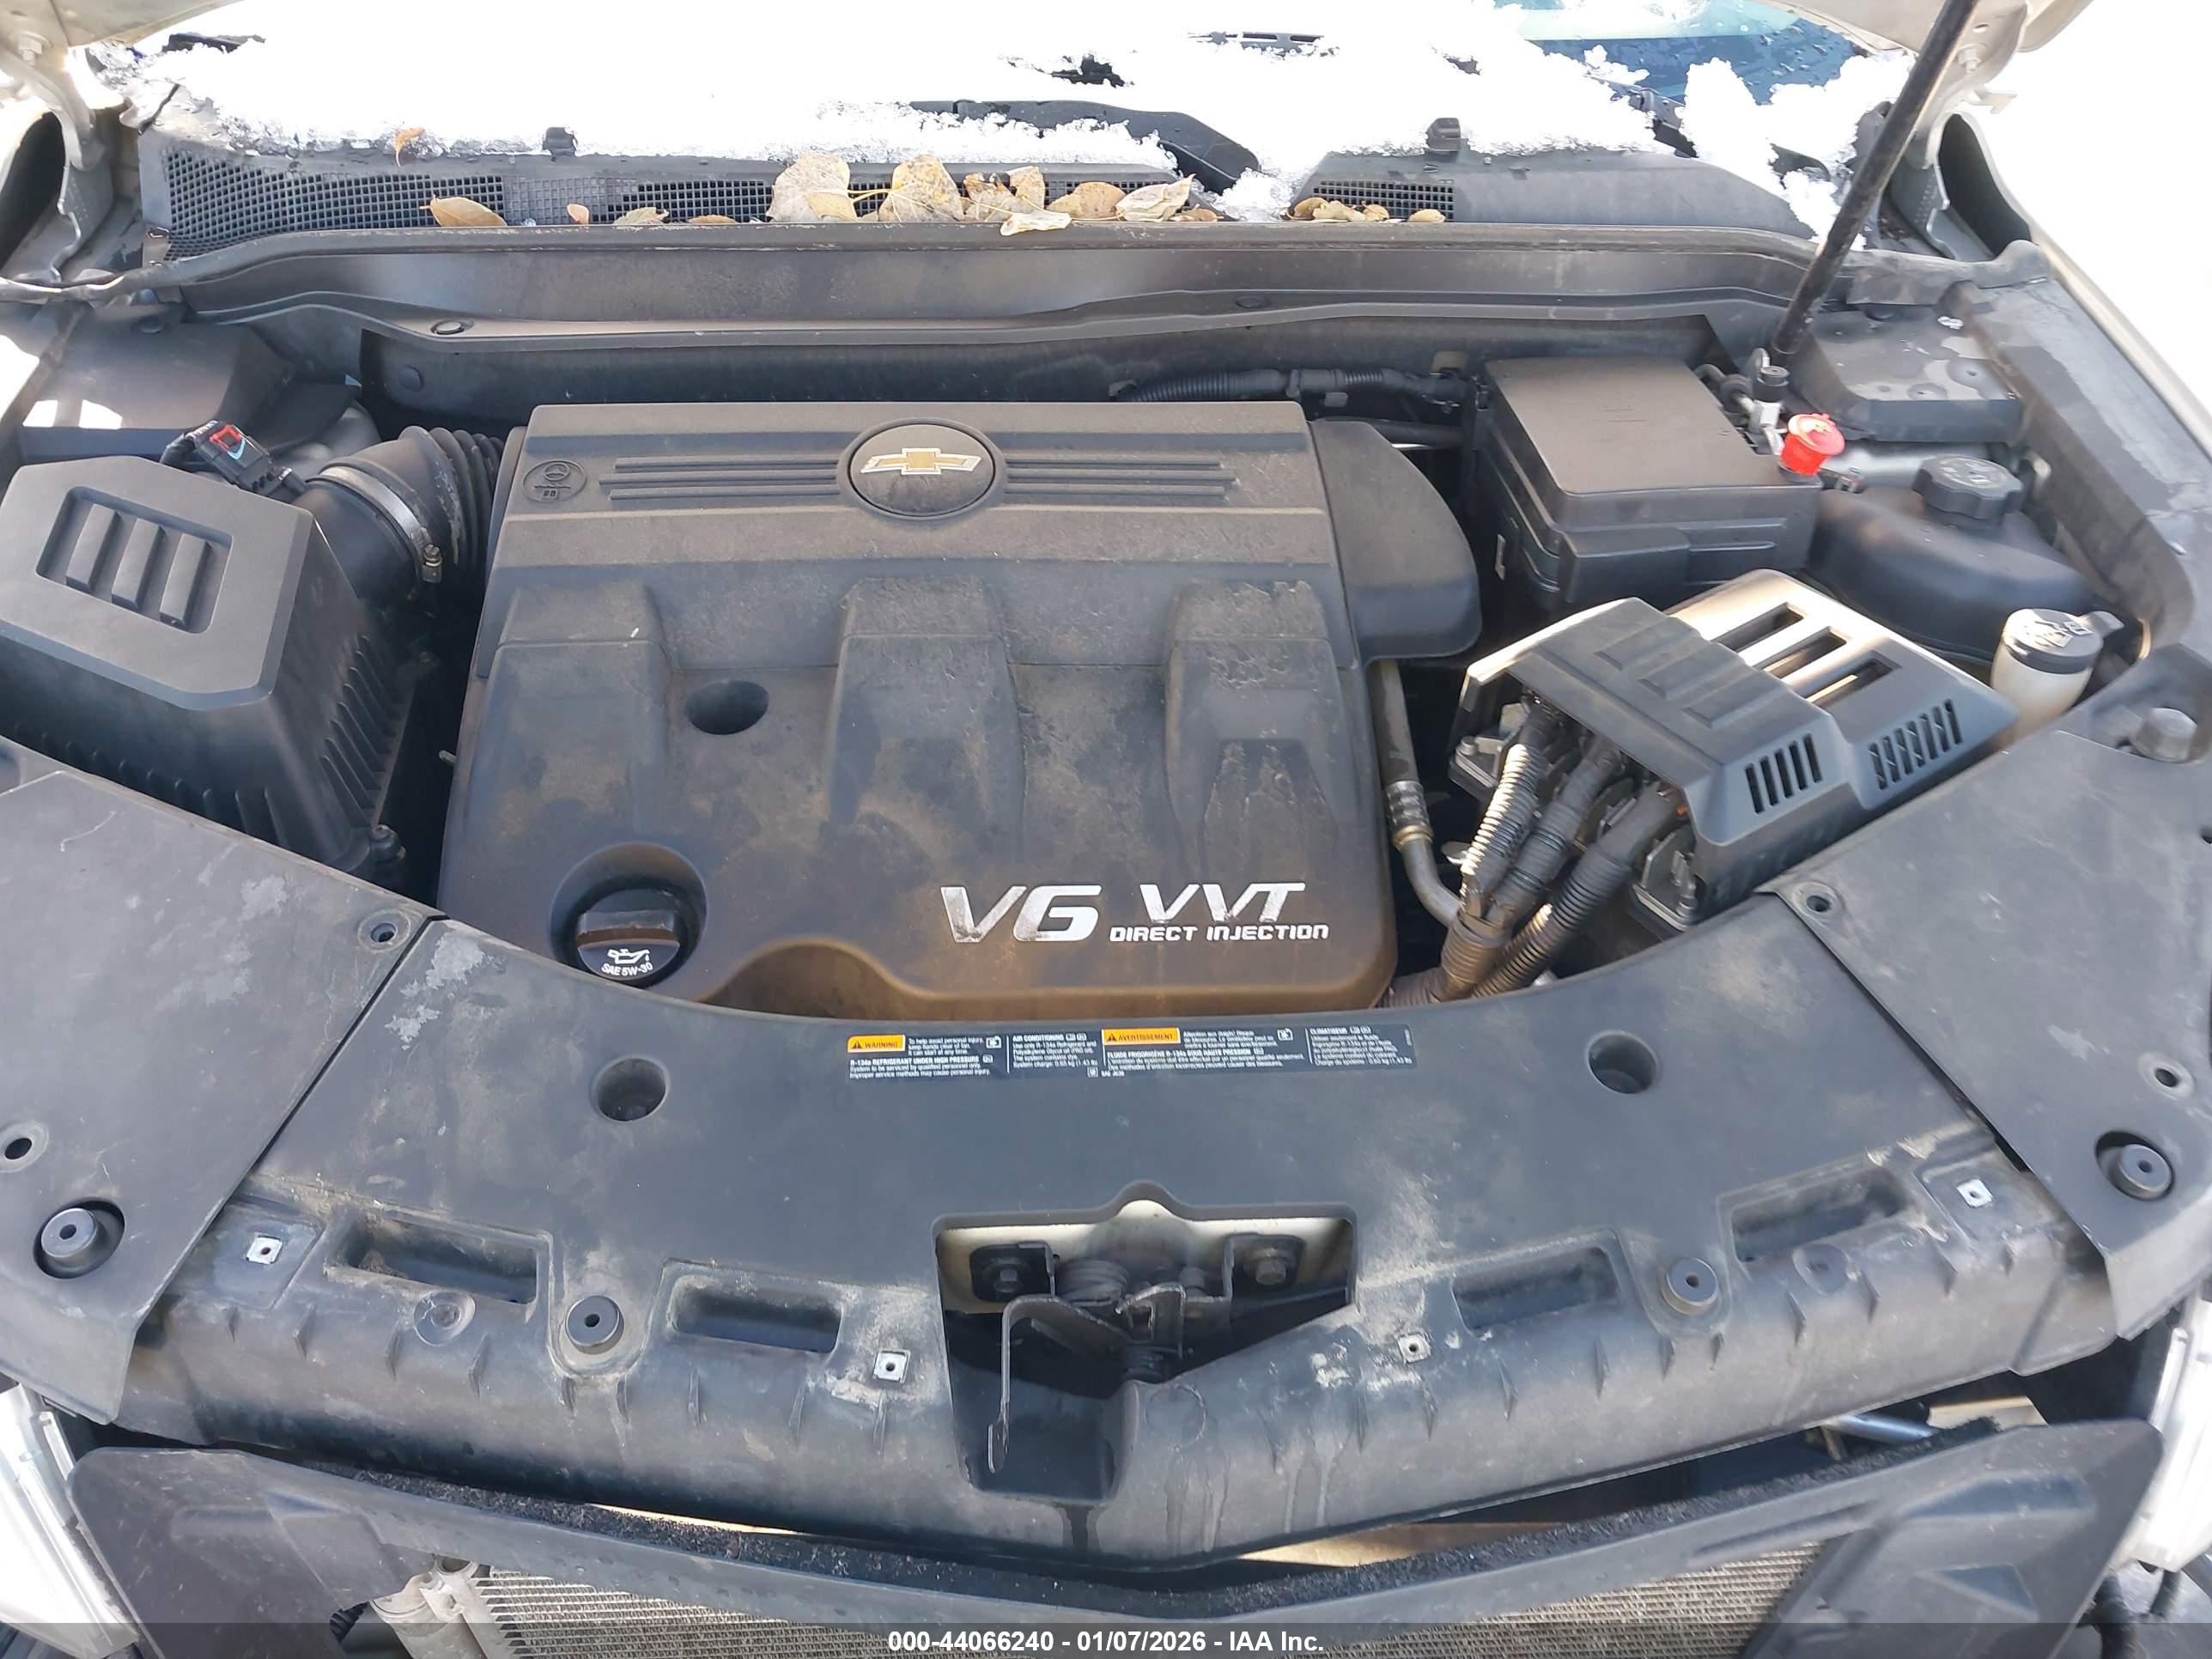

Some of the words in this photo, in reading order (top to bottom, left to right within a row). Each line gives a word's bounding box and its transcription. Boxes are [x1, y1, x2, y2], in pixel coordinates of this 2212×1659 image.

[940, 884, 1103, 943] V6
[1139, 882, 1306, 923] VVT
[1109, 925, 1198, 942] DIRECT
[1206, 923, 1329, 941] INJECTION
[601, 963, 621, 976] SAE
[621, 962, 653, 976] 5W-30
